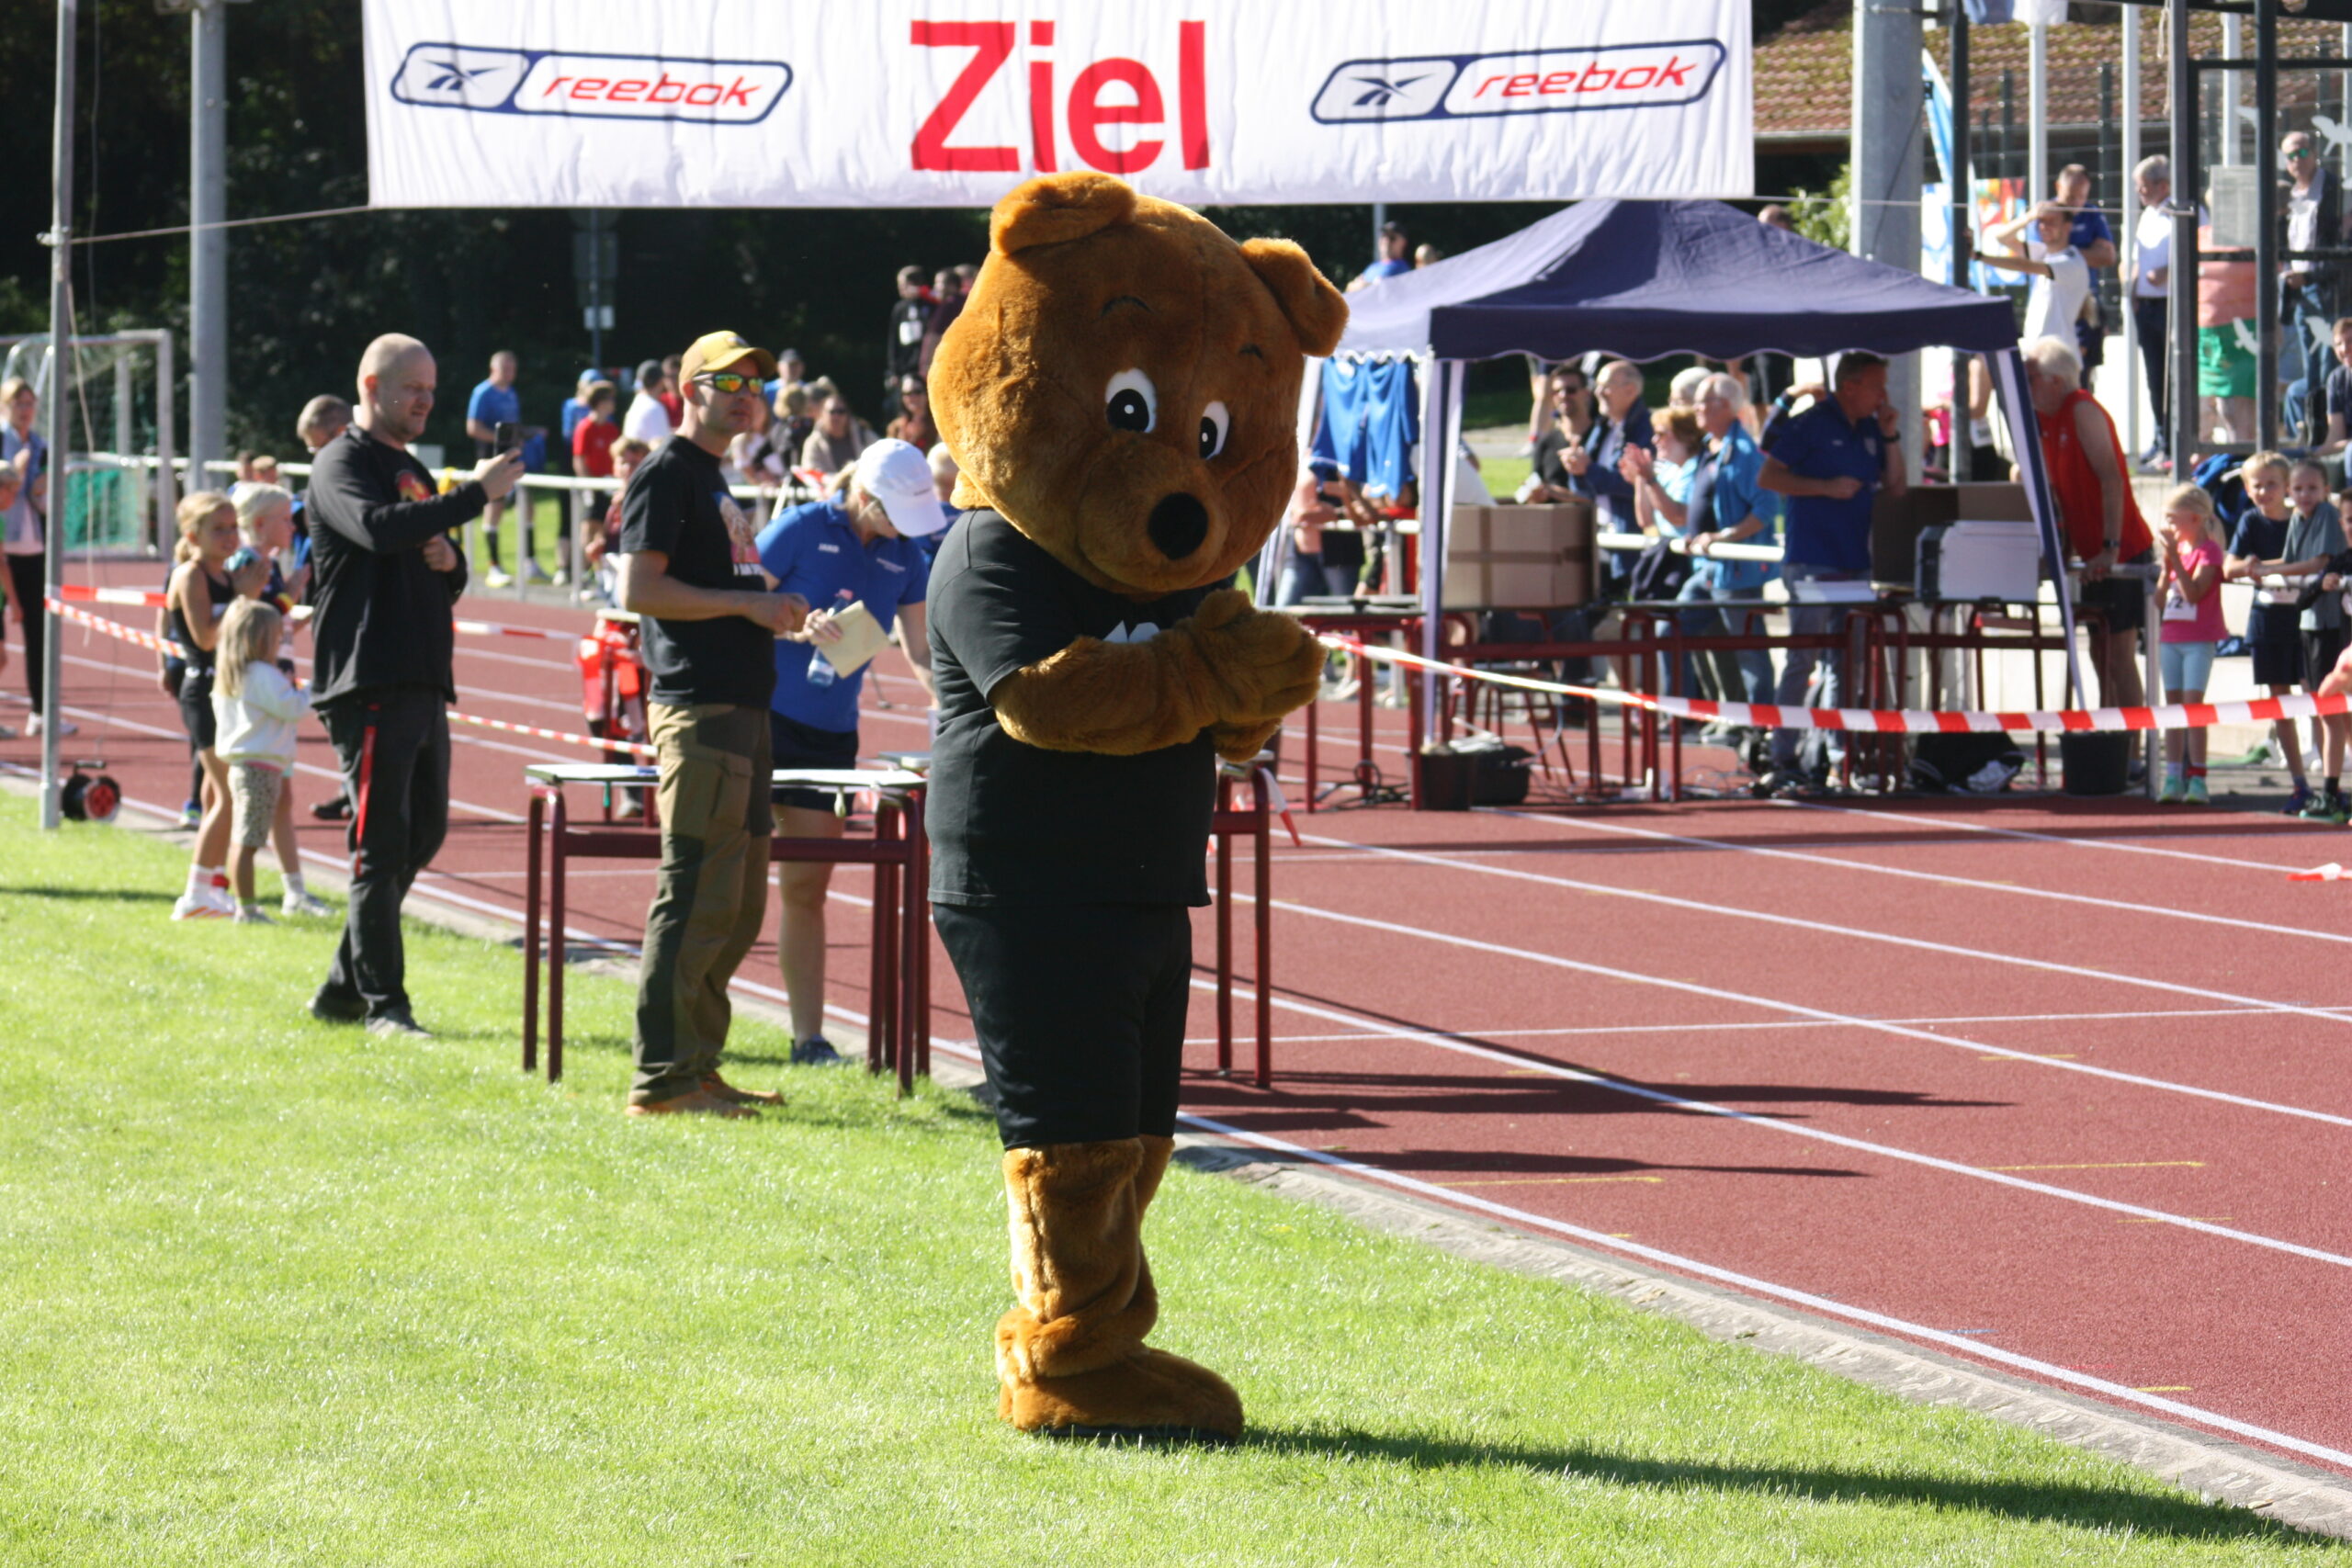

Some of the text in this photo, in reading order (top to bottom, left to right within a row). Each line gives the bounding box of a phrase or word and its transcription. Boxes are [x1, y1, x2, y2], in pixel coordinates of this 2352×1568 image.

[542, 73, 763, 107] reebok
[910, 19, 1211, 175] Ziel
[1473, 55, 1698, 98] reebok
